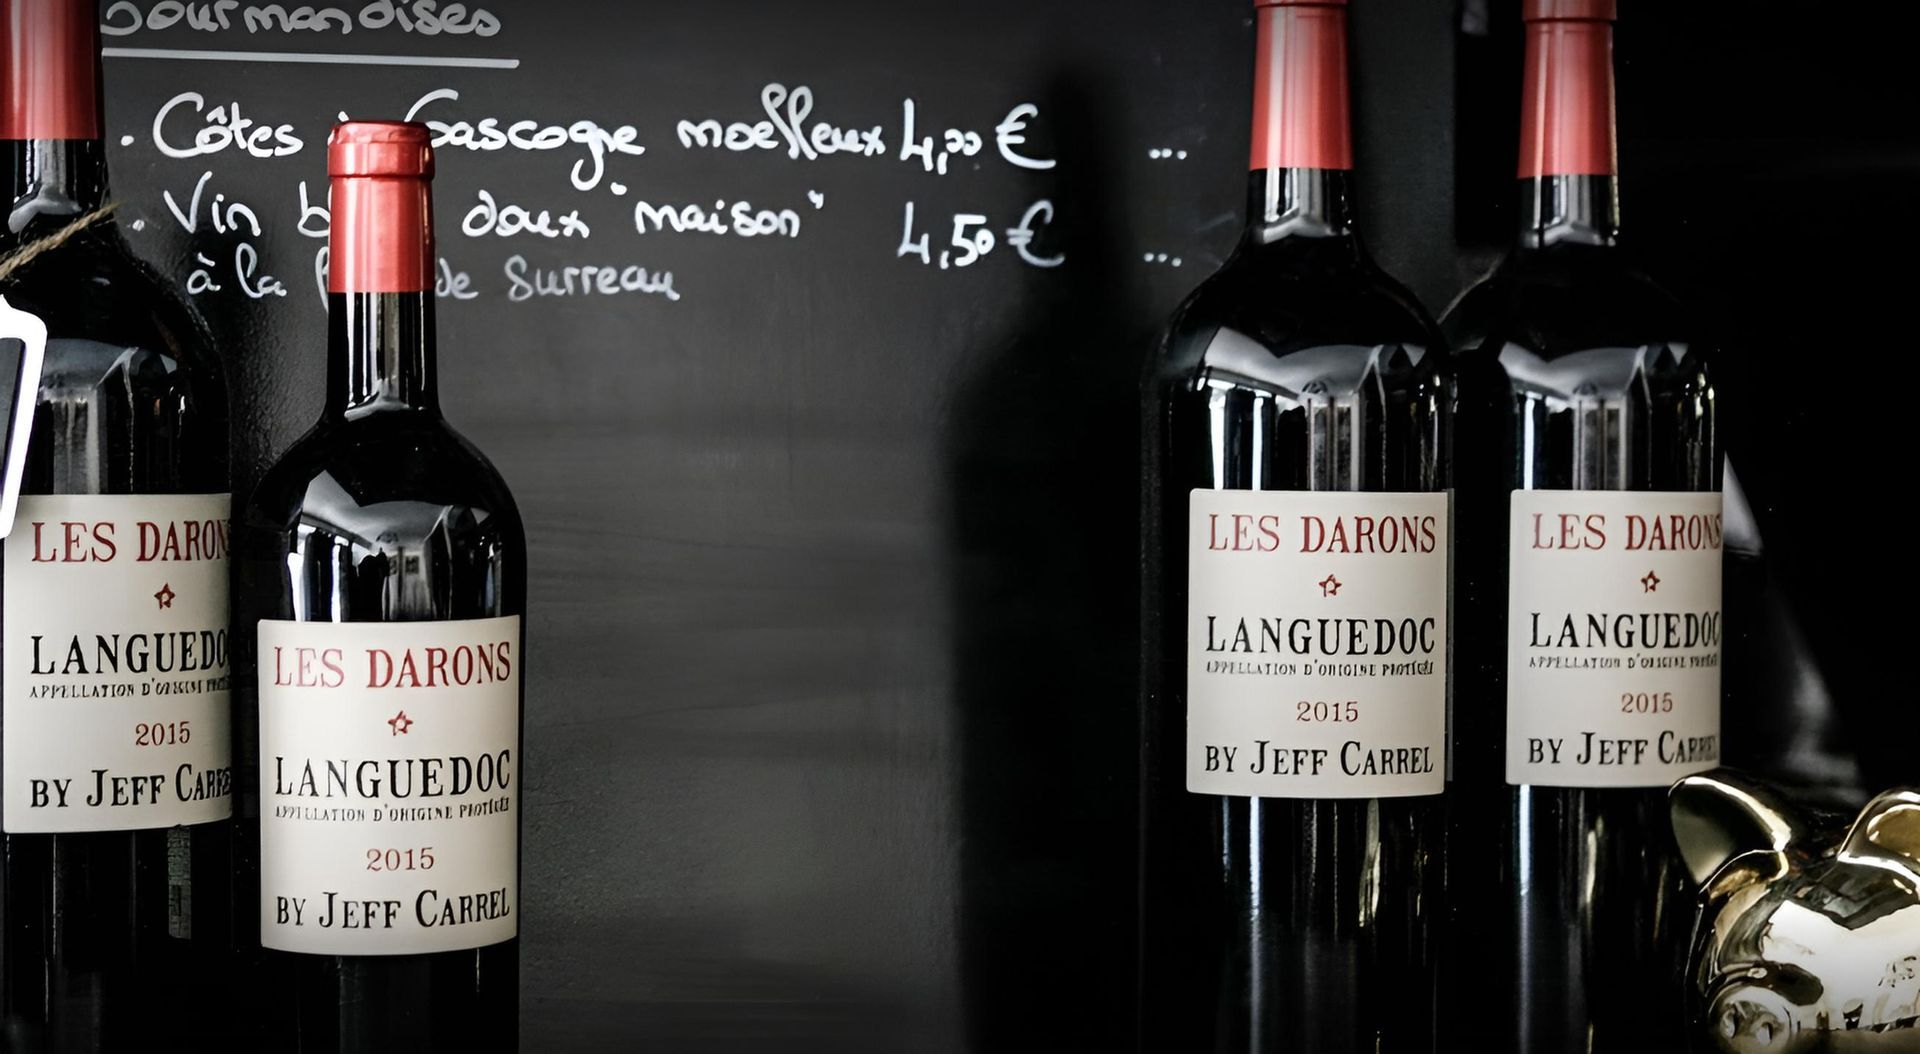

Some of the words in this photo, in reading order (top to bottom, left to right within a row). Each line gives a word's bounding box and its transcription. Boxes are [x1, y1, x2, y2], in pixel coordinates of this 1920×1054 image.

[152, 92, 304, 158] Côtes
[163, 170, 262, 237] Vin
[898, 201, 995, 269] 4,50
[235, 242, 287, 299] la
[31, 521, 116, 562] LES
[136, 519, 232, 561] DARON
[1208, 514, 1280, 552] LES
[1299, 515, 1436, 553] DARONS
[1532, 513, 1606, 549] LES
[30, 627, 232, 675] LANGUEDO
[1205, 615, 1435, 656] LANGUEDOC
[274, 646, 345, 687] LES
[365, 641, 511, 688] DARONS
[1296, 701, 1359, 723] 2015
[1621, 692, 1673, 713] 2015
[135, 721, 191, 746] 2015
[1528, 737, 1563, 764] BY
[1576, 732, 1648, 765] JEFF
[275, 749, 510, 798] LANGUEDOC
[1205, 745, 1237, 773] BY
[1250, 740, 1328, 776] JEFF
[1340, 741, 1434, 776] CARREL
[30, 779, 72, 808] BY
[87, 769, 166, 807] JEFF
[175, 763, 232, 802] CARRE
[366, 847, 434, 871] 2015
[276, 896, 306, 926] BY
[318, 891, 401, 929] JEFF
[415, 887, 511, 928] CARREL
